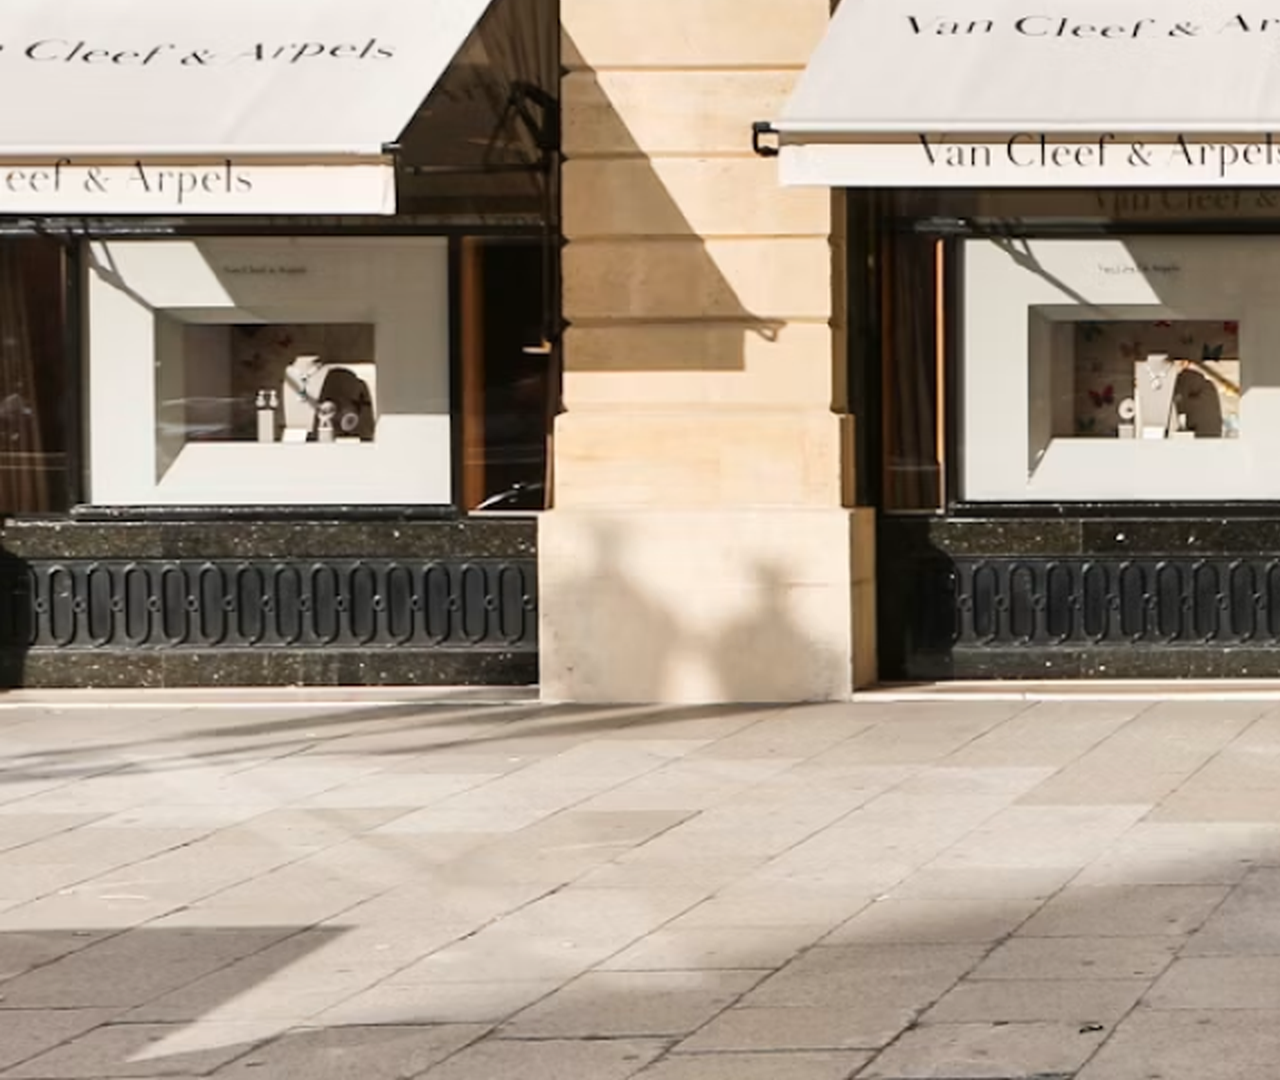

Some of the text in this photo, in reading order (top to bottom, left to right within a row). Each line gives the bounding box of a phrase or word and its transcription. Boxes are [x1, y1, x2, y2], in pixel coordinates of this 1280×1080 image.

[906, 15, 994, 36] Van
[1014, 16, 1155, 38] Cleef
[1167, 20, 1201, 38] &
[25, 39, 176, 67] Cleef
[181, 50, 216, 66] &
[232, 38, 397, 64] Arpels
[918, 133, 992, 168] Van
[1007, 132, 1114, 168] Cleef
[1127, 138, 1153, 168] &
[83, 165, 110, 193] &
[127, 159, 253, 204] Arpels
